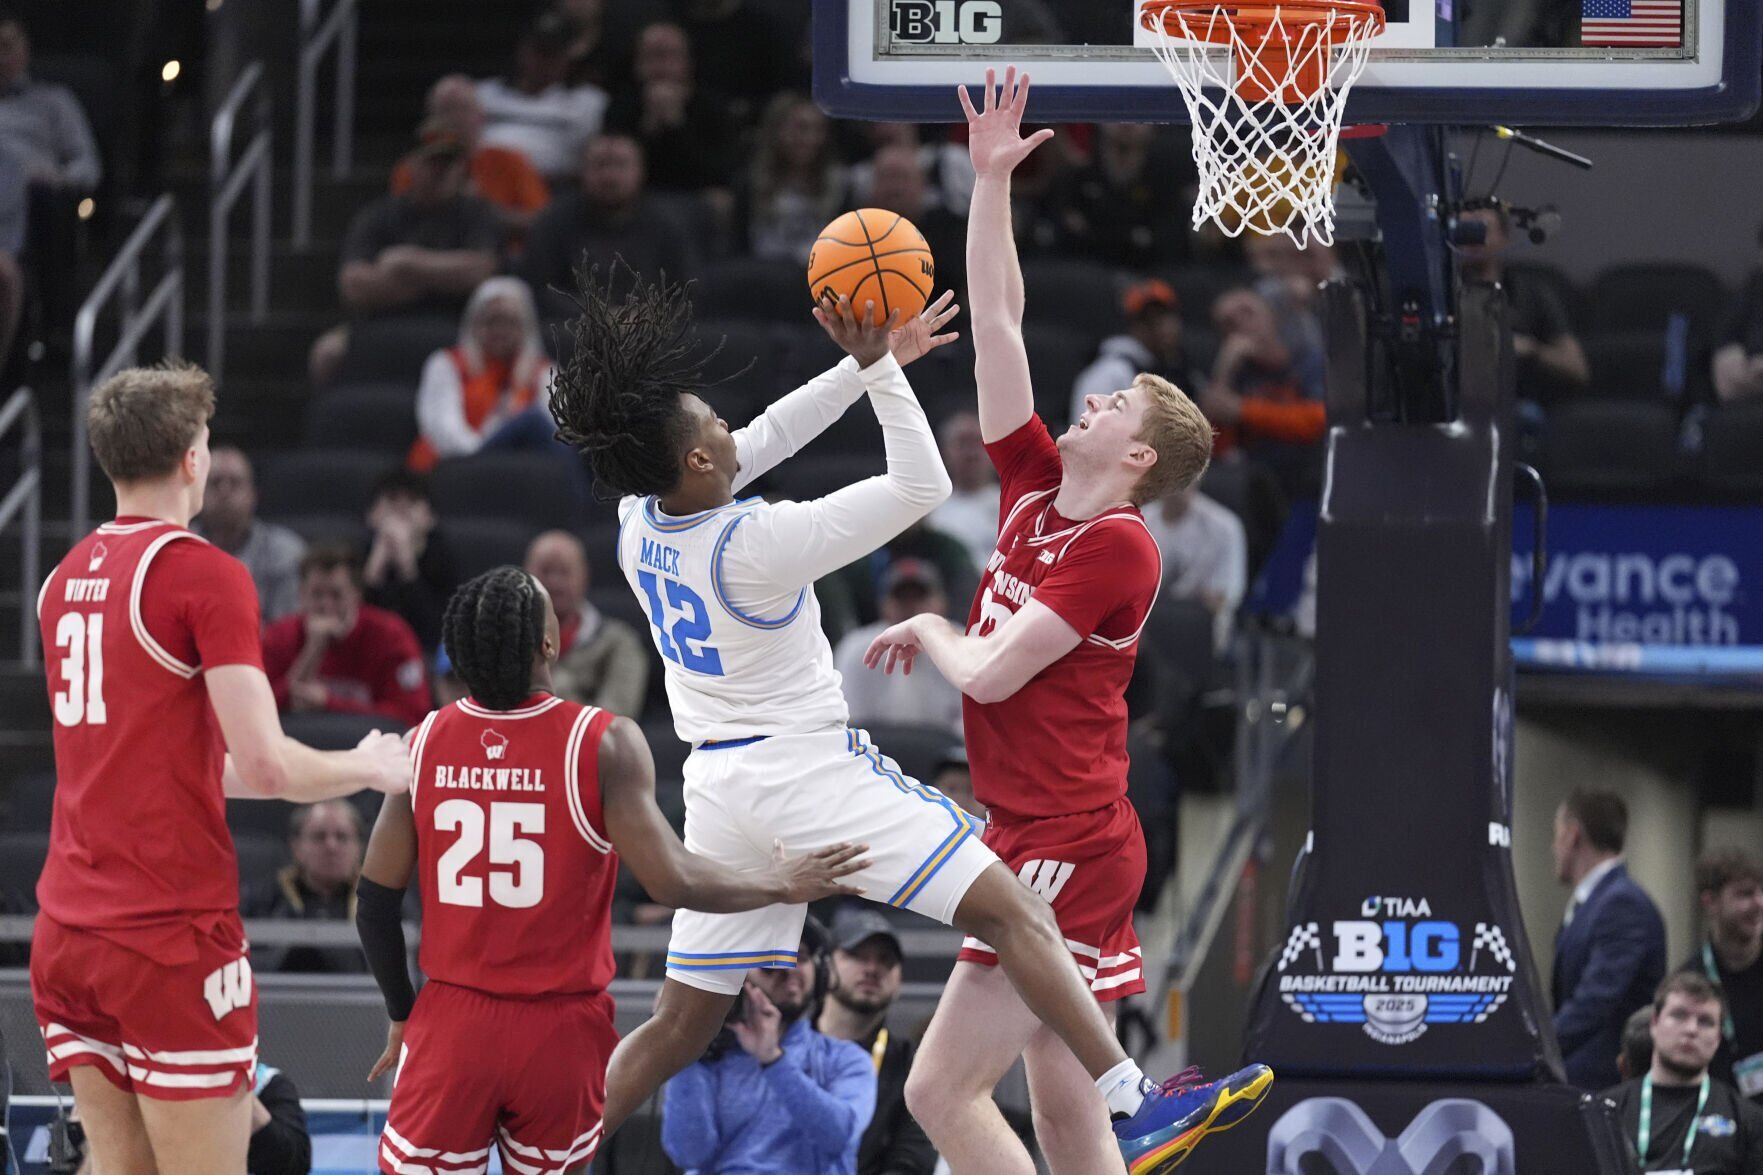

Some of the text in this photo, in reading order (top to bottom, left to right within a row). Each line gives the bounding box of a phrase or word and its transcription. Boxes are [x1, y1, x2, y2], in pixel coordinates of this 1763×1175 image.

[640, 537, 681, 577] MACK
[637, 569, 726, 677] 12
[1577, 600, 1739, 647] Health
[54, 611, 107, 727] 31
[434, 765, 546, 792] BLACKWELL
[433, 798, 546, 910] 25
[1382, 897, 1432, 918] TIAA
[203, 954, 252, 1022] W
[1279, 975, 1513, 993] BASKETBALL TOURNAMENT
[1375, 998, 1416, 1012] 2025
